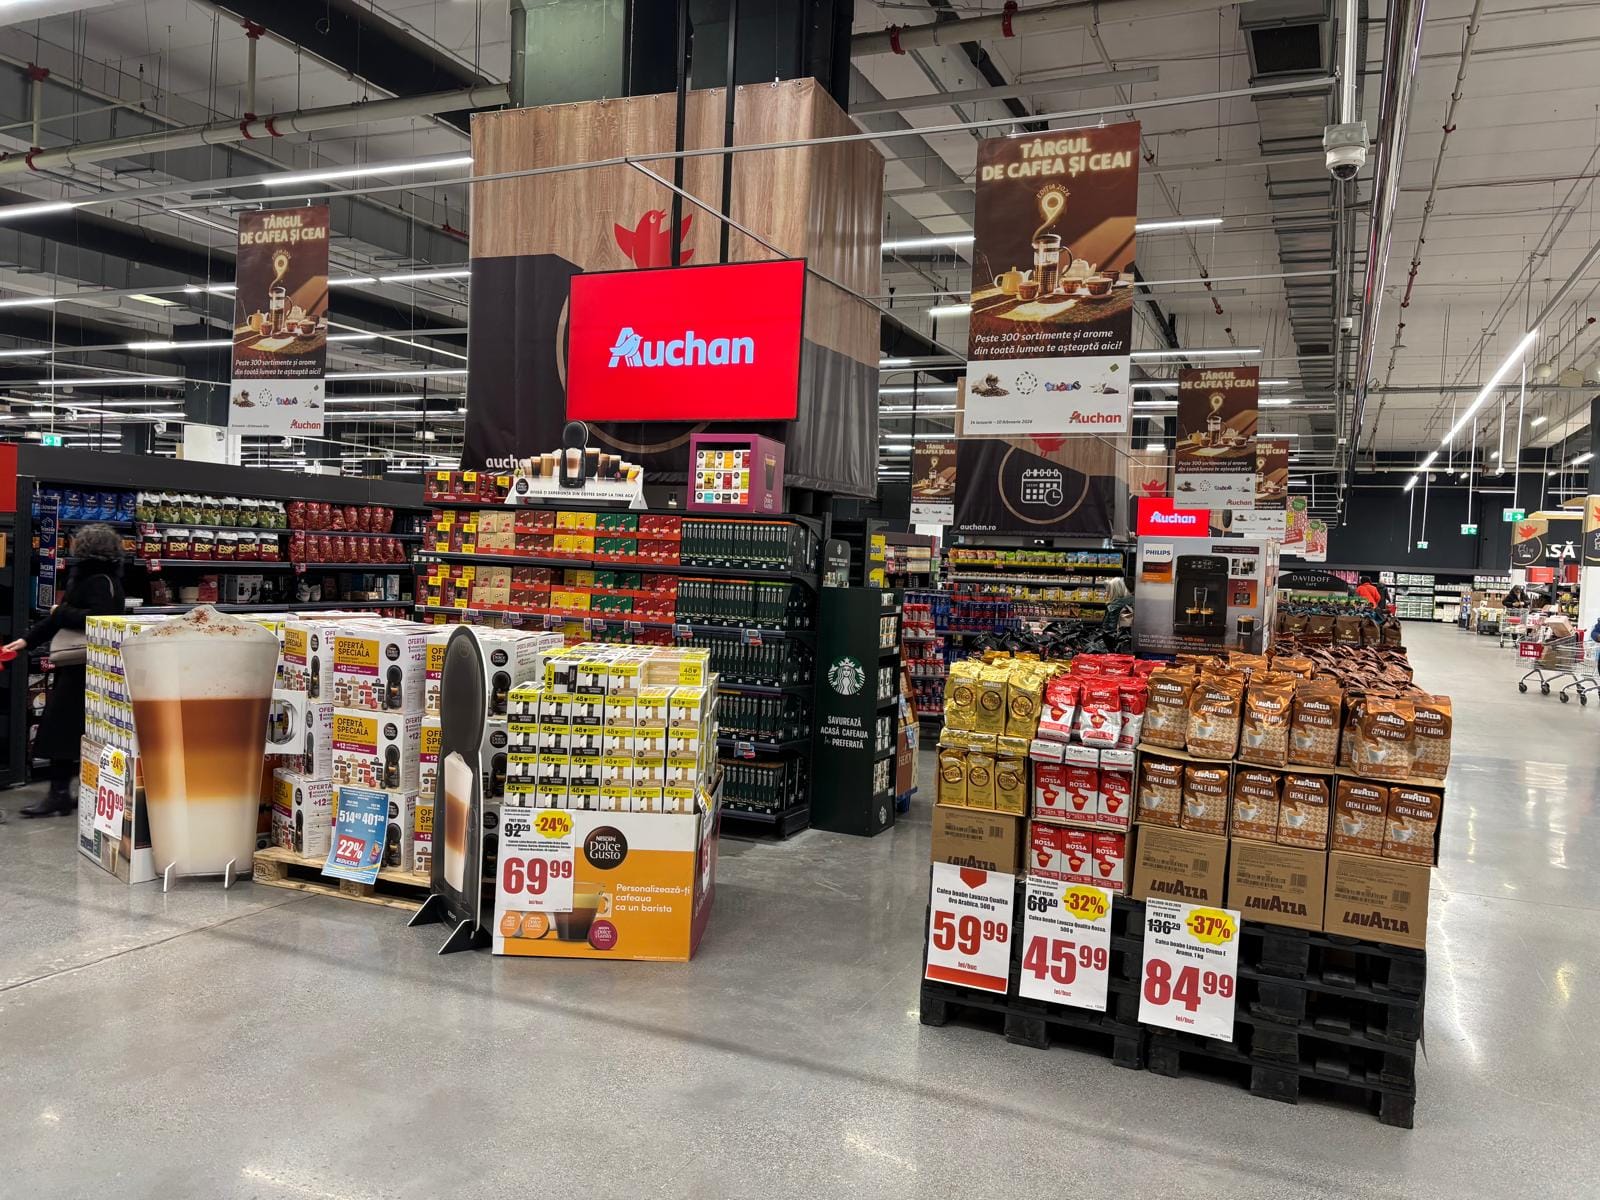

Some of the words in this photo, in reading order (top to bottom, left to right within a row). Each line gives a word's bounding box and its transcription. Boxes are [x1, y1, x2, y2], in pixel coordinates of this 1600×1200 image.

[1020, 138, 1092, 158] TÂRGUL
[982, 164, 1004, 181] DE
[1008, 158, 1065, 178] CAFEA
[1068, 156, 1085, 178] ȘI
[1088, 151, 1132, 171] CEAI
[262, 214, 304, 230] TÂRGUL
[240, 232, 254, 244] DE
[254, 230, 288, 244] CAFEA
[290, 228, 300, 245] ȘI
[302, 227, 326, 240] CEAI
[975, 334, 999, 343] Peste
[1000, 332, 1020, 342] 300
[1022, 330, 1072, 340] sortimente
[1073, 330, 1082, 340] și
[1082, 330, 1114, 339] arome
[608, 327, 754, 368] Auchan
[974, 346, 989, 356] din
[990, 345, 1015, 355] toată
[1016, 344, 1044, 354] lumea
[1046, 343, 1056, 352] te
[1057, 342, 1100, 354] așteaptă
[1101, 341, 1123, 350] aici!
[1200, 370, 1236, 380] TÂRGUL
[1181, 381, 1193, 389] DE
[1194, 380, 1223, 389] CAFEA
[1234, 379, 1256, 388] CEAI
[1069, 410, 1122, 424] Auchan
[290, 419, 320, 430] Auchan
[1226, 498, 1252, 506] Auchan
[1150, 511, 1196, 524] Auchan
[1292, 575, 1330, 583] DAVIDOFF
[338, 640, 364, 649] OFERTĂ
[338, 648, 370, 658] SPECIALĂ
[1156, 683, 1182, 692] LAVAZZA
[1304, 702, 1330, 710] LAVAZZA
[337, 718, 363, 727] OFERTĂ
[828, 716, 861, 727] SAVUREAZĂ
[1299, 714, 1313, 723] CREMA
[1317, 716, 1332, 725] AROMA
[337, 726, 368, 736] SPECIALĂ
[820, 726, 840, 735] ACASĂ
[842, 728, 868, 739] CAFEAUA
[832, 738, 864, 749] PREFERATĂ
[1401, 793, 1431, 803] LAVAZZA
[1396, 806, 1411, 814] CREMA
[1416, 809, 1433, 818] AROMA
[535, 817, 569, 832] -24%
[337, 839, 363, 859] 22%
[590, 840, 621, 852] Dolce
[589, 849, 621, 860] Gusto
[1096, 848, 1117, 856] ROSSA
[616, 884, 691, 896] Personalizează-ți
[1150, 879, 1208, 901] LAVAZZA
[616, 894, 652, 902] cafeaua
[969, 892, 988, 902] Lavazza
[642, 904, 672, 913] barista
[980, 902, 990, 910] 500
[1064, 893, 1103, 914] -32%
[1245, 895, 1307, 916] LAVAZZA
[1187, 915, 1230, 939] -37%
[1342, 911, 1409, 934] LAVAZZA
[1186, 943, 1205, 952] Lavazza
